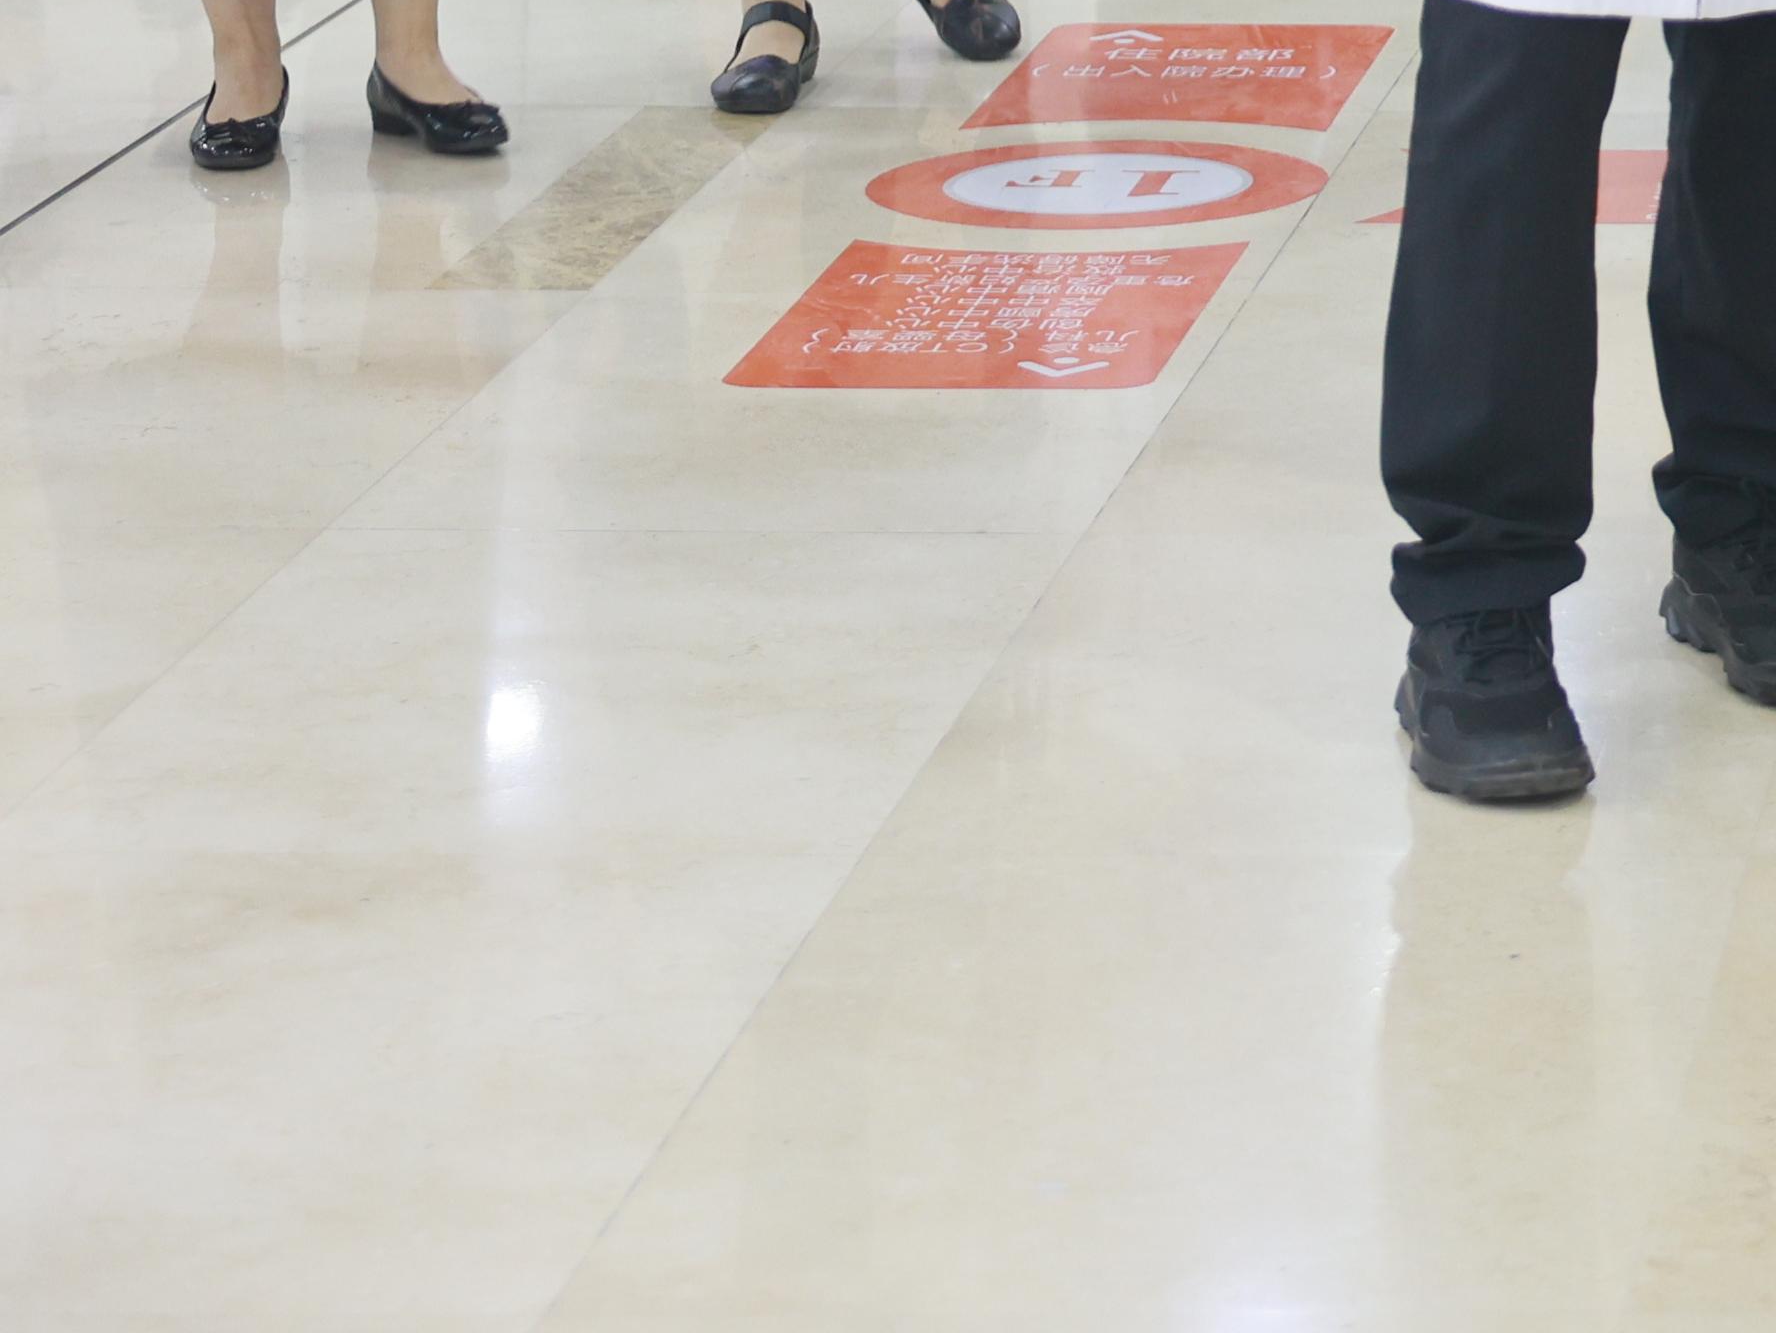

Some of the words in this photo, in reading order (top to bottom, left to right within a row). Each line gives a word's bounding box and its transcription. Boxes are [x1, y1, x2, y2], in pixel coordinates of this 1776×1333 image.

[1104, 46, 1297, 62] 住院部
[900, 253, 1173, 266] 无障碍洗手间
[906, 294, 1104, 307] 卒中中心
[885, 317, 1084, 330] 创伤中心
